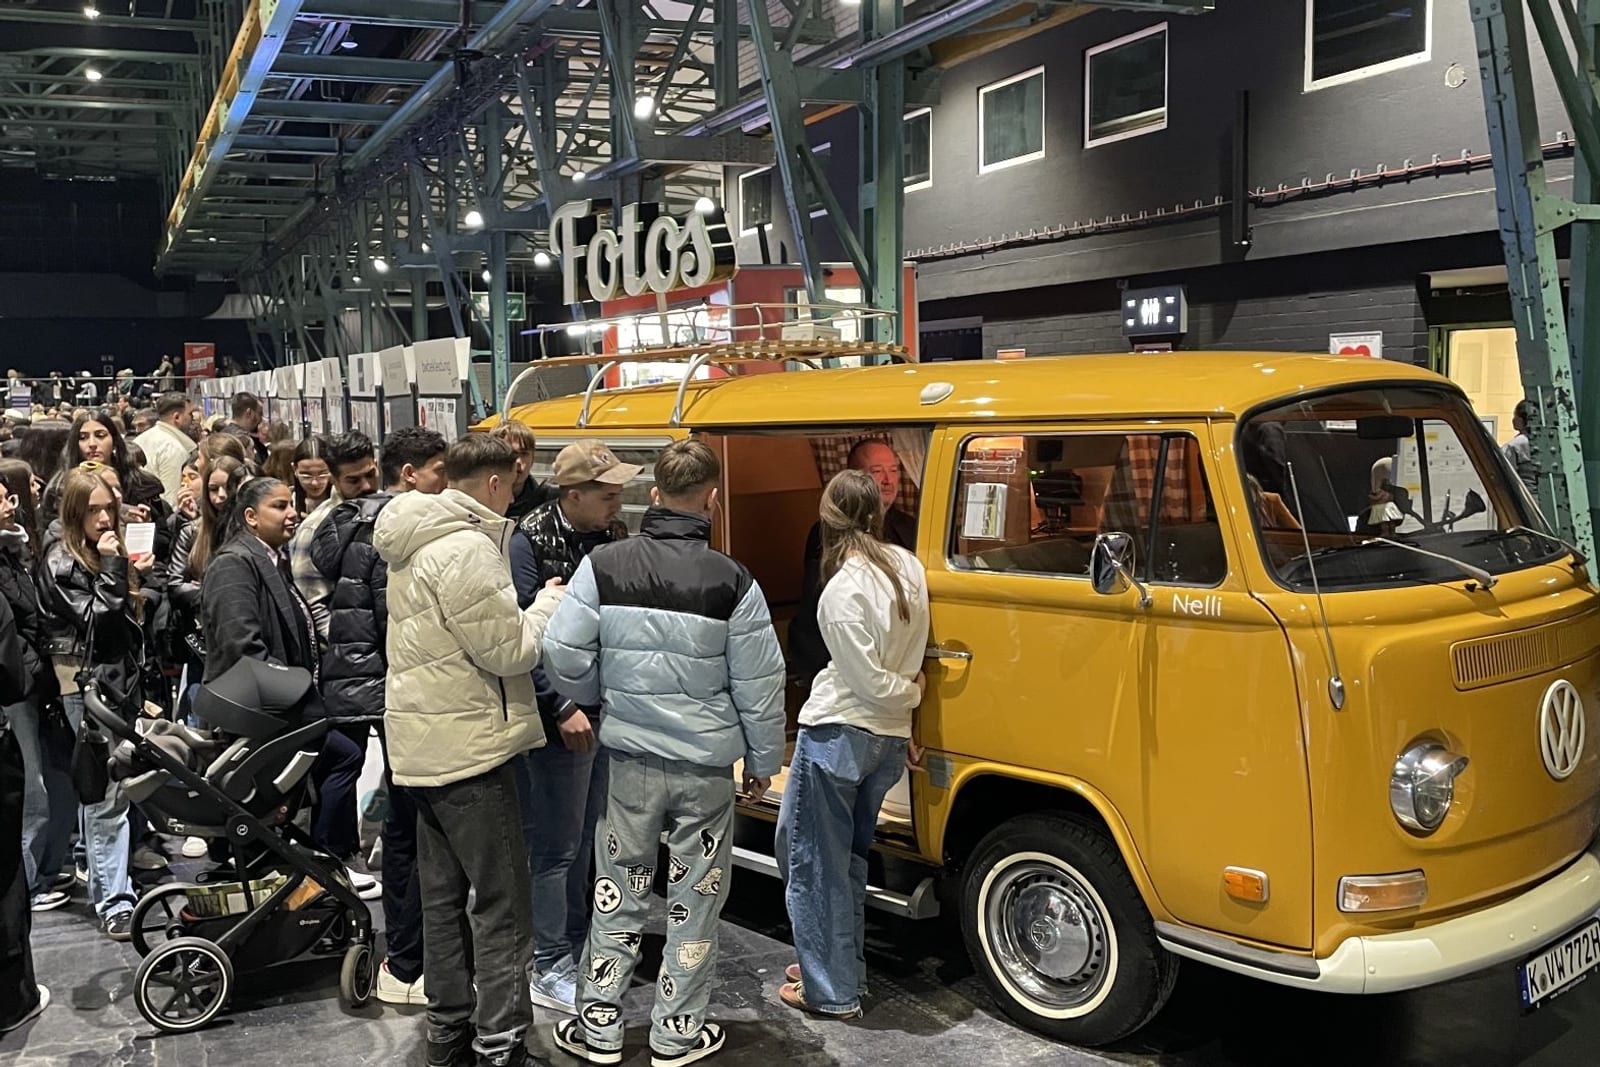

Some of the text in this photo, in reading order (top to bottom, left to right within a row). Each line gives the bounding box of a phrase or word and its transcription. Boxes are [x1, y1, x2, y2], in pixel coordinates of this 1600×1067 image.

[549, 198, 716, 305] Fotos
[1173, 593, 1222, 616] Nelli
[1543, 681, 1583, 775] VW
[629, 876, 650, 890] NFL
